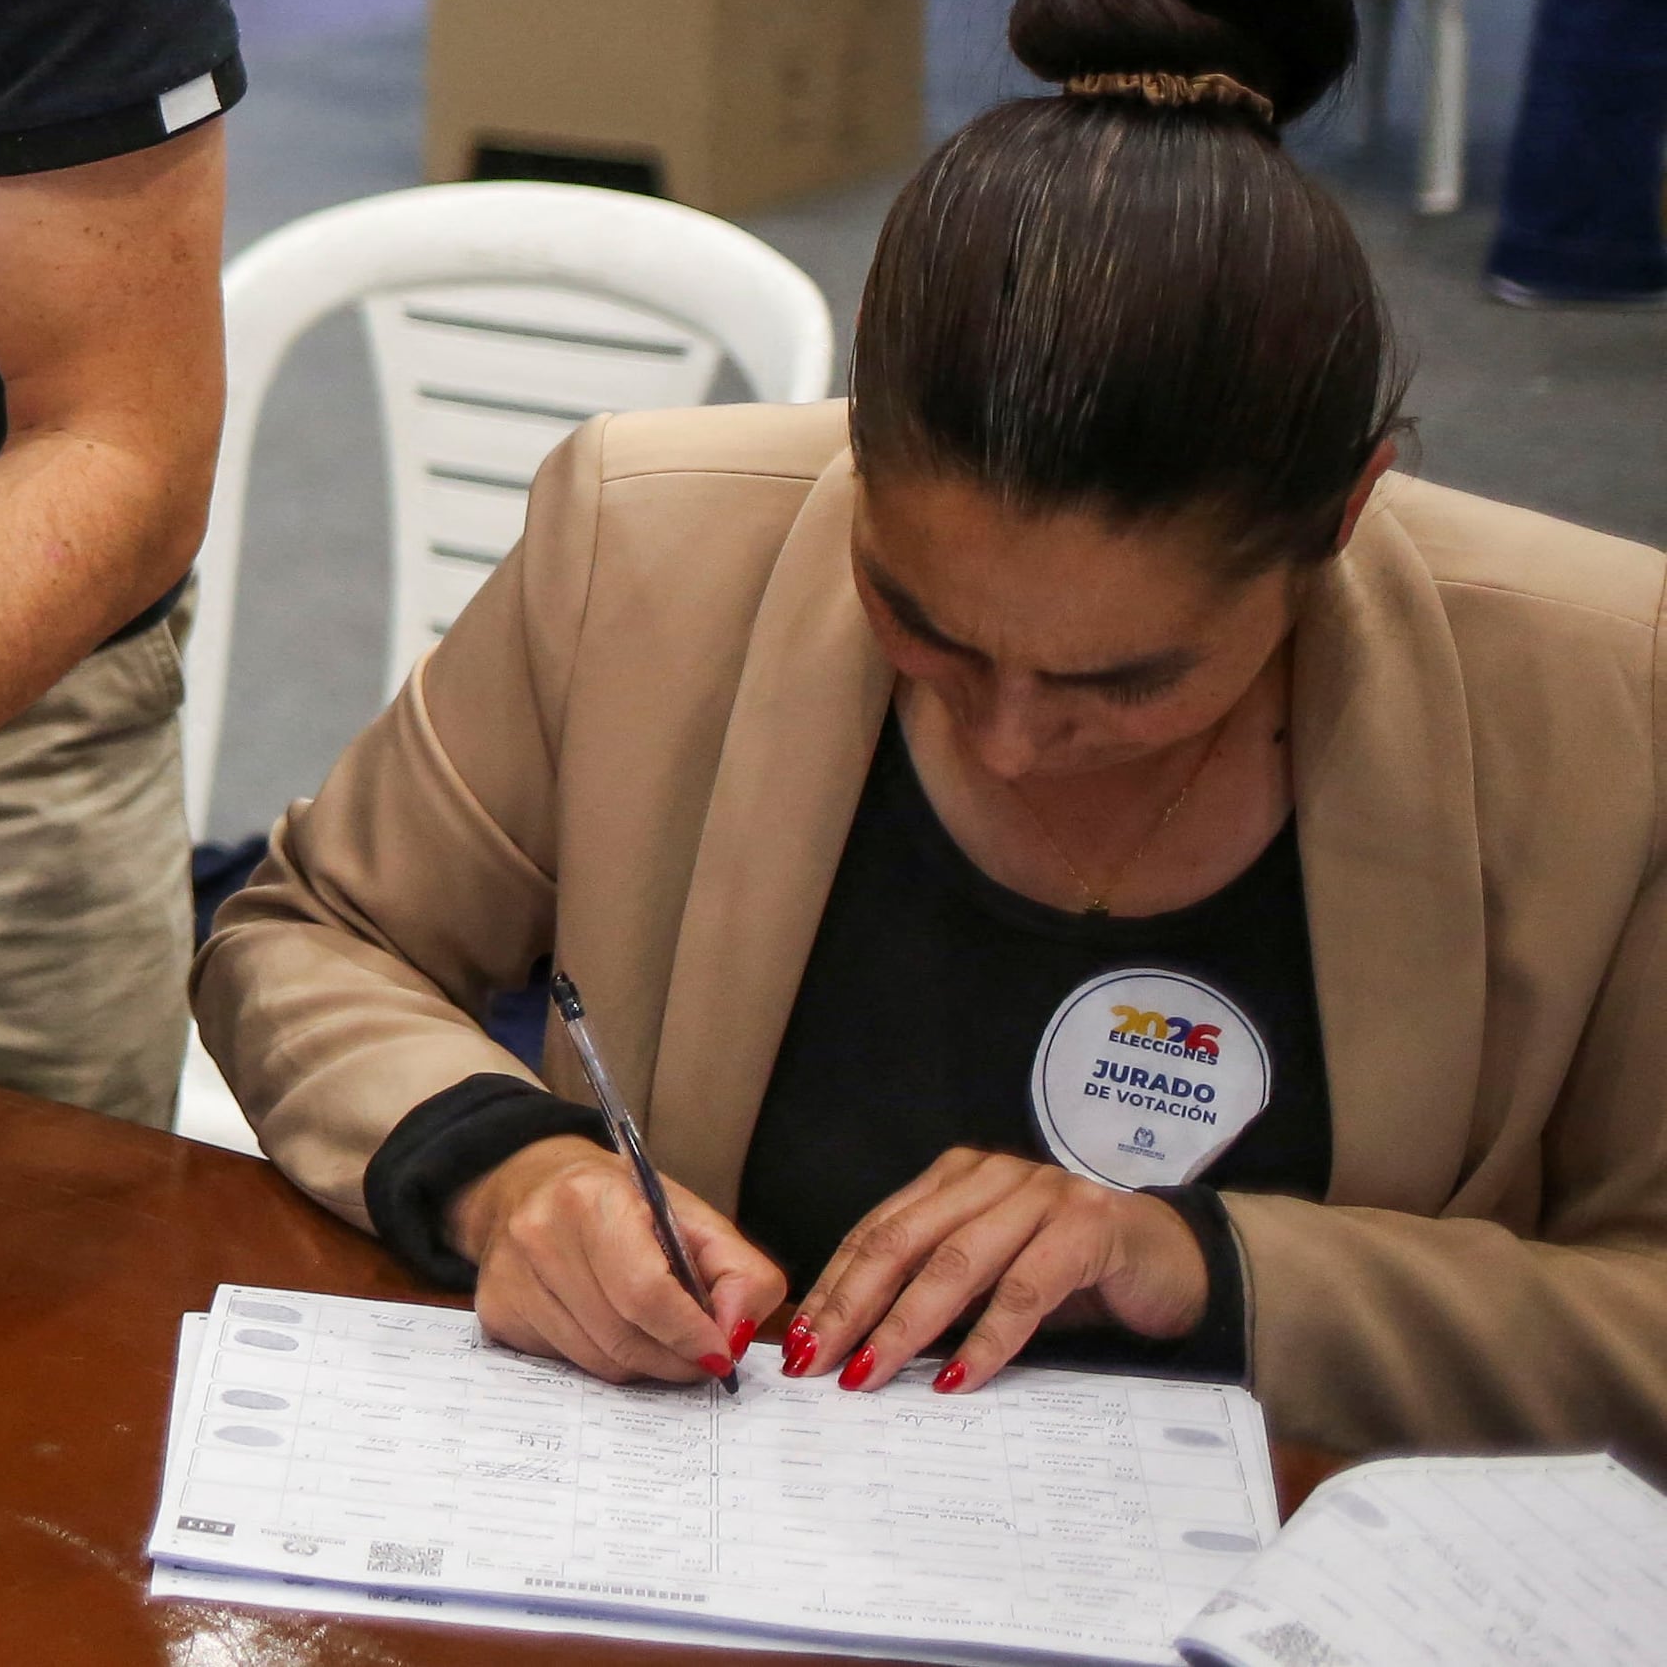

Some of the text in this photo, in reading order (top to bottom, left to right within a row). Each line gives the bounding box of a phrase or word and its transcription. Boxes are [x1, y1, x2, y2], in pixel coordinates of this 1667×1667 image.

[1108, 1031, 1218, 1066] ELECCIONES
[1110, 1004, 1222, 1058] 2026
[1092, 1059, 1216, 1104] JURADO
[1083, 1083, 1217, 1126] DE VOTACIÓN
